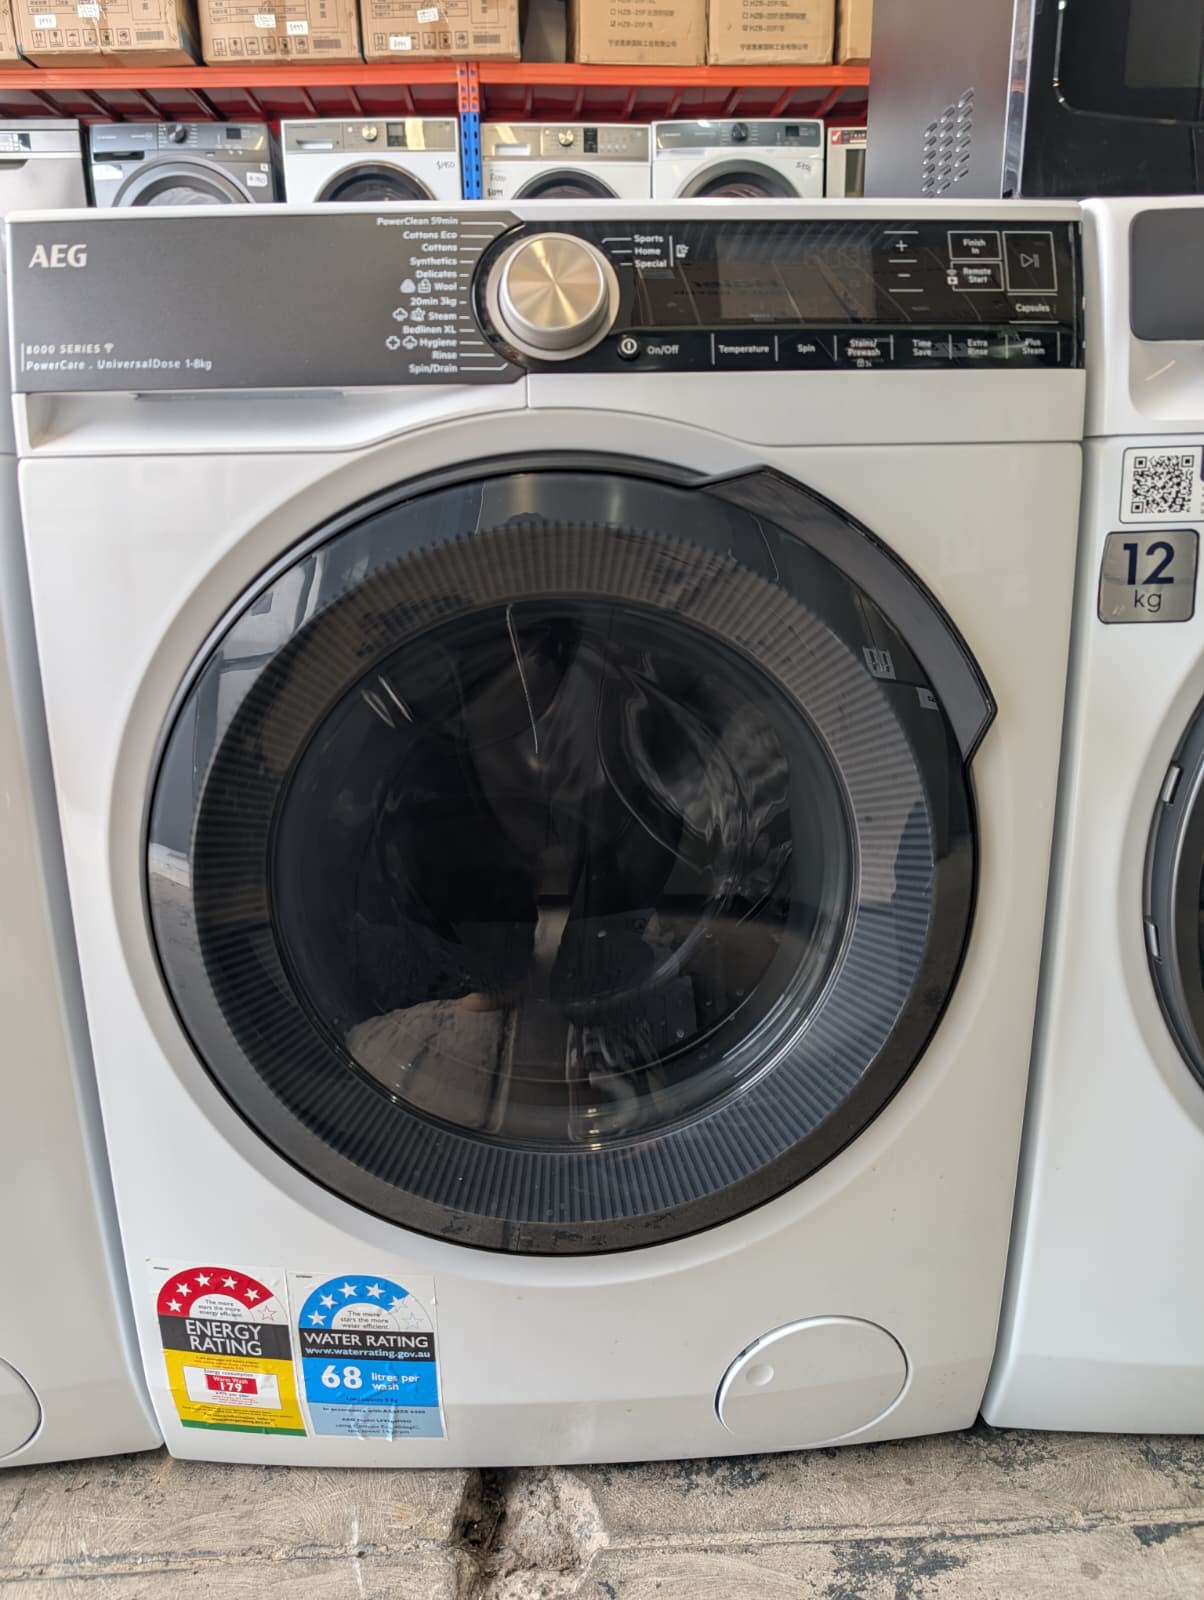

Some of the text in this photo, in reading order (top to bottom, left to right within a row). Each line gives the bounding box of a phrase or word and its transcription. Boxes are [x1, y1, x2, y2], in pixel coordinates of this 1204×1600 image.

[376, 216, 458, 226] PowerClean 59min
[403, 231, 458, 240] Cottons Eco
[634, 234, 664, 244] Sports
[421, 243, 458, 252] Cottons
[962, 238, 987, 247] Finish
[28, 244, 88, 268] AEG
[634, 247, 661, 256] Home
[410, 257, 458, 267] Synthetics
[634, 259, 667, 269] Special
[416, 270, 457, 278] Delicates
[962, 267, 992, 275] Remote
[968, 275, 988, 284] Start
[434, 282, 457, 291] Wool
[410, 297, 457, 307] 20min 3kg
[1015, 303, 1051, 314] Capsules
[428, 312, 457, 320] Steam
[403, 326, 456, 334] Bedlinen XL
[419, 338, 457, 348] Hygiene
[912, 339, 932, 347] Time
[967, 338, 988, 347] Extra
[26, 343, 101, 355] 8000 SERIES
[647, 344, 680, 355] On/Off
[719, 344, 770, 355] Temperature
[797, 344, 816, 354] Spin
[912, 348, 932, 356] Save
[1022, 346, 1046, 355] Steam
[432, 351, 457, 360] Rinse
[26, 360, 85, 371] PowerCare
[97, 358, 181, 370] UniversalDose
[409, 364, 458, 374] Spin/Drain
[1123, 541, 1175, 585] 12
[1134, 590, 1162, 613] kg
[185, 1319, 262, 1340] ENERGY
[304, 1332, 429, 1348] WATER RATING
[189, 1336, 263, 1356] RATING
[305, 1346, 431, 1359] www.waterrating.gov.au
[321, 1365, 420, 1389] 68 litres per
[220, 1382, 243, 1392] 179
[372, 1382, 399, 1391] wash
